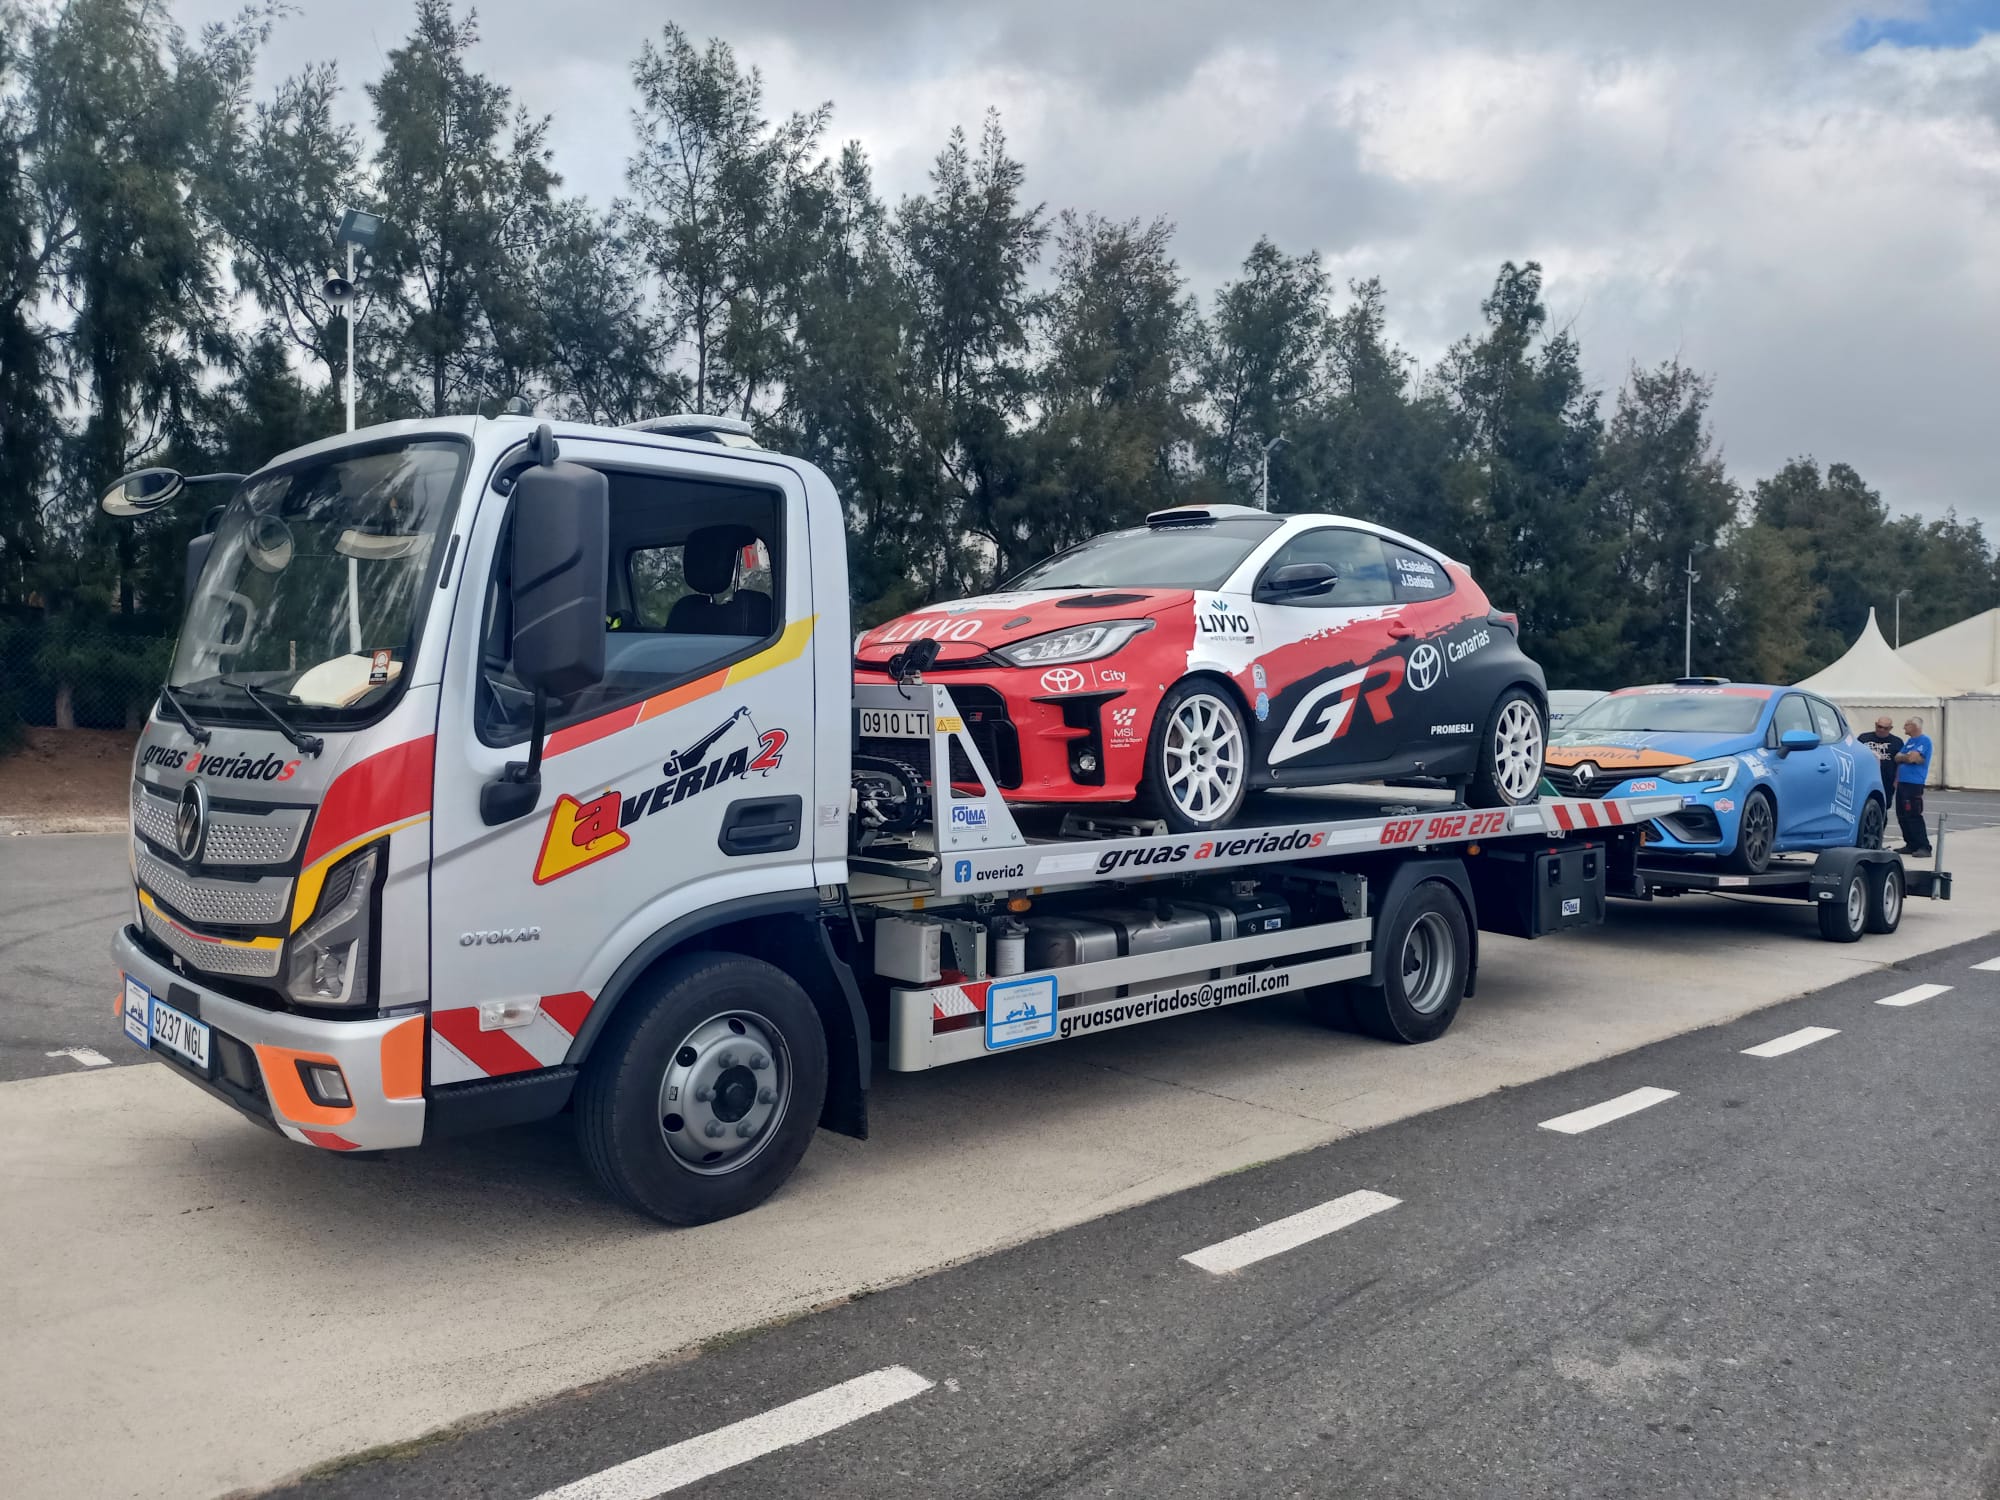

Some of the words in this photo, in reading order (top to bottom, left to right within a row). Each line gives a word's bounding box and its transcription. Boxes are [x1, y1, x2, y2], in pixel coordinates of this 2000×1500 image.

[880, 618, 984, 643] LIVVO
[1199, 614, 1250, 633] LIVVO
[1447, 629, 1490, 662] Canarias
[1100, 669, 1126, 682] City
[1645, 687, 1724, 696] MOTRIO
[1268, 655, 1406, 766] GR
[863, 712, 900, 734] 0910
[905, 712, 930, 735] LT
[1430, 723, 1474, 736] PROMESLI
[141, 744, 188, 767] gruas
[185, 751, 302, 782] averiados
[1631, 781, 1657, 792] AON
[1380, 819, 1424, 845] 687
[1425, 815, 1467, 840] 962
[1468, 811, 1506, 836] 272
[1096, 843, 1191, 875] gruas
[1193, 829, 1325, 861] averiados
[976, 863, 1025, 881] averia2
[459, 926, 542, 947] OTOKAR
[1060, 973, 1289, 1038] gruasaveriados@gmail.com
[155, 1007, 181, 1045] 9237
[184, 1021, 204, 1060] NGL
